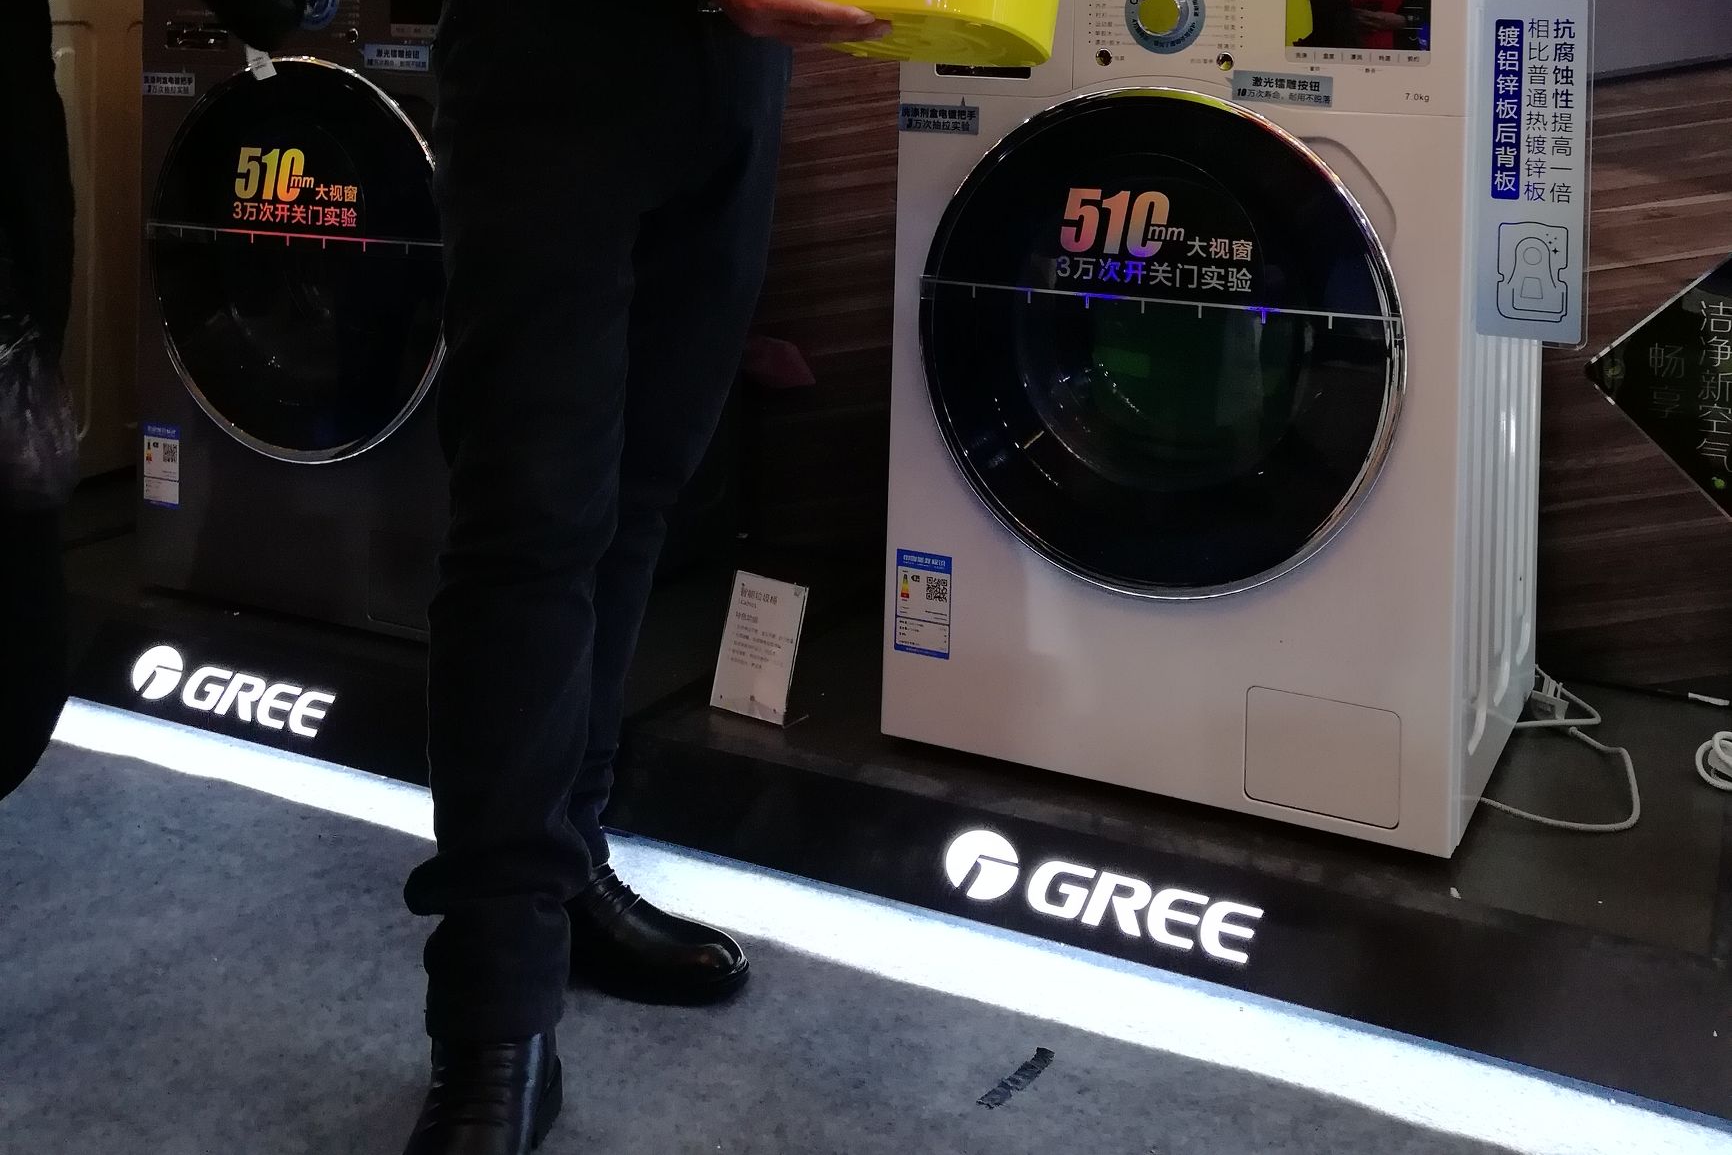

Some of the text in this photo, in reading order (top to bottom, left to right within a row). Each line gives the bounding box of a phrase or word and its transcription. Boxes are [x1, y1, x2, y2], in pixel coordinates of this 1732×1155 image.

[1252, 76, 1320, 93] 激光镭雕按钮
[1404, 92, 1430, 103] 7.0kg
[1494, 25, 1521, 192] 镀铝锌板后背板
[1524, 18, 1550, 203] 相比普通热镀锌板
[1550, 18, 1576, 204] 抗腐蚀性提高一倍
[233, 201, 358, 227] 3万次开关门实验
[315, 184, 358, 203] 大视窗
[1057, 255, 1252, 293] 3万次开关门实验
[1186, 236, 1253, 262] 大视窗
[1697, 300, 1732, 473] 洁净新空气
[182, 666, 337, 738] GREE
[1027, 860, 1265, 964] GREE
